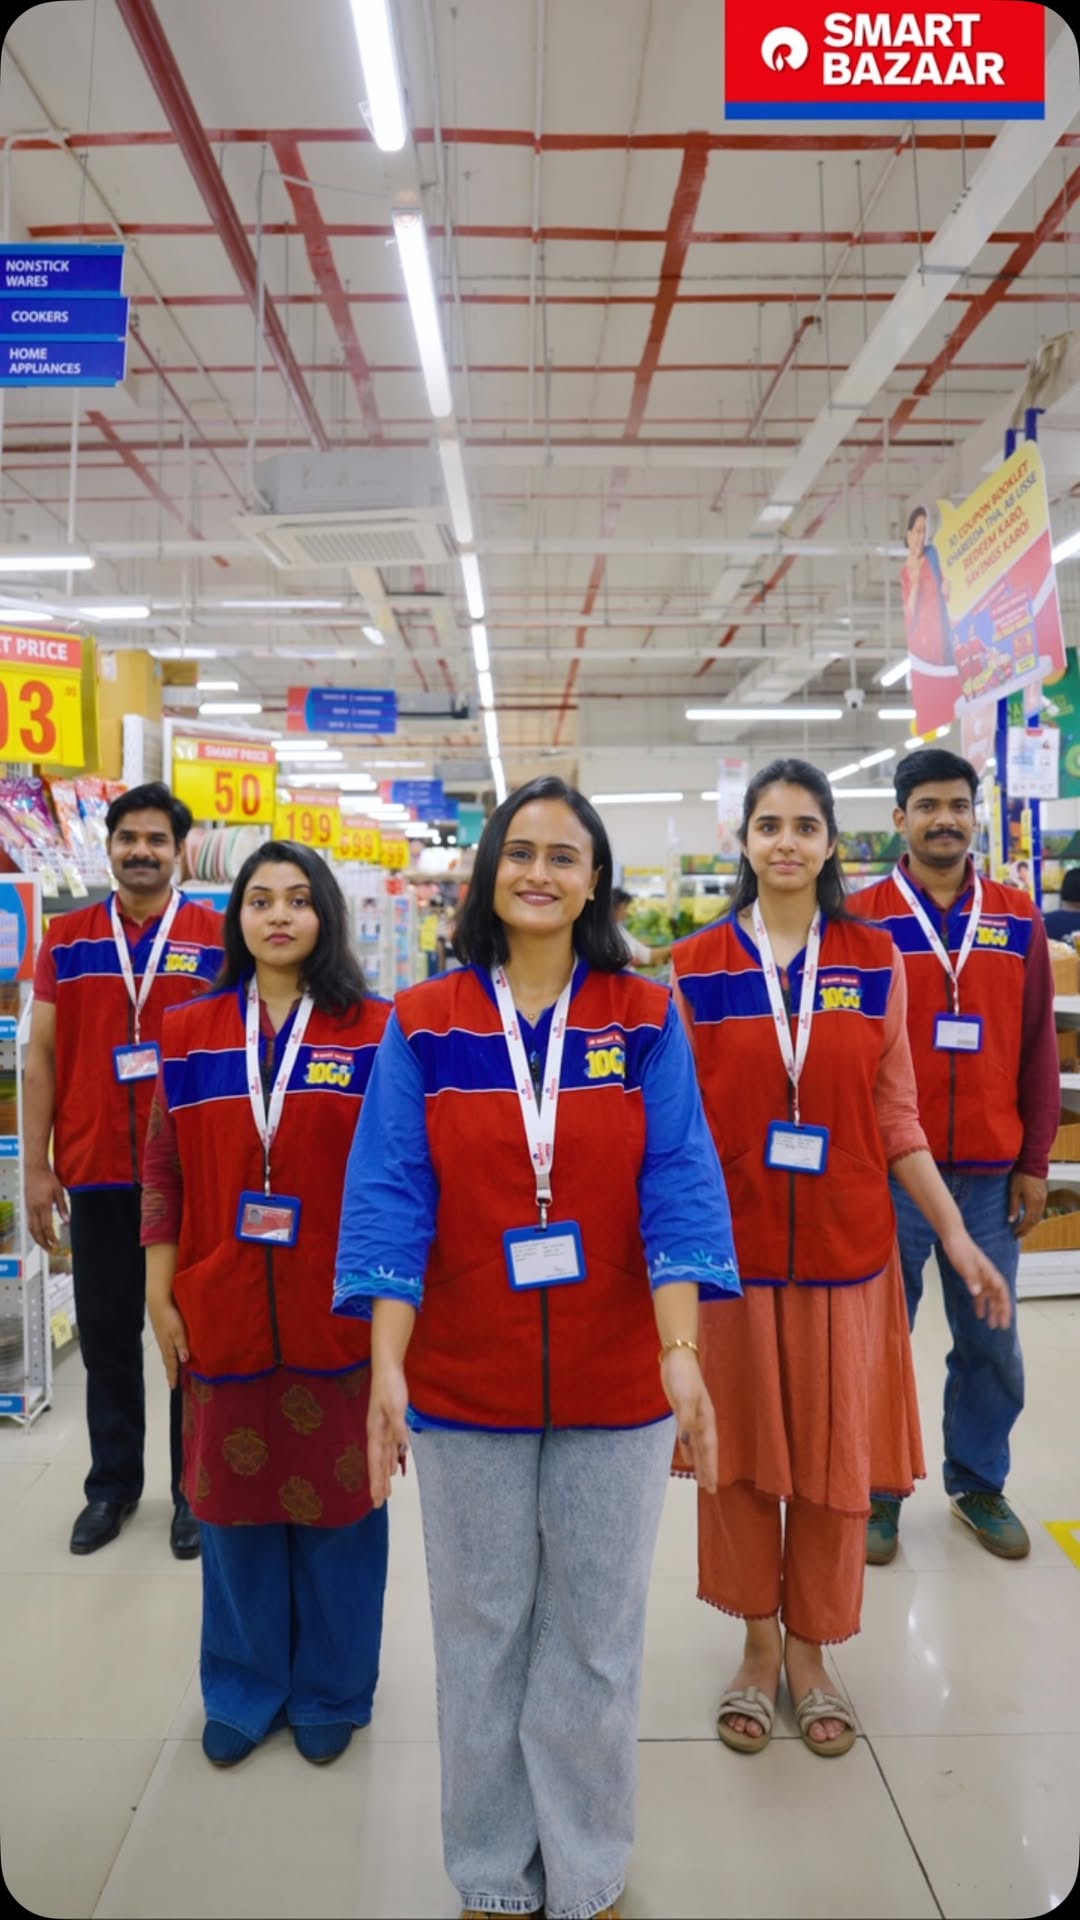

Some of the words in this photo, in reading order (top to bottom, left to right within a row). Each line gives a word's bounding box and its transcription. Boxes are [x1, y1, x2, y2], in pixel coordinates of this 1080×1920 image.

[6, 260, 70, 272] NONSTICK
[6, 275, 48, 287] WARES
[11, 310, 69, 322] COOKERS
[9, 348, 48, 360] HOME
[9, 363, 81, 374] APPLIANCES
[958, 501, 991, 538] COUPON
[991, 460, 1028, 504] BOOKLET
[963, 532, 997, 569] REDEEM
[16, 637, 68, 661] PRICE
[0, 680, 56, 755] 3
[215, 771, 260, 816] 50
[287, 811, 331, 843] 199
